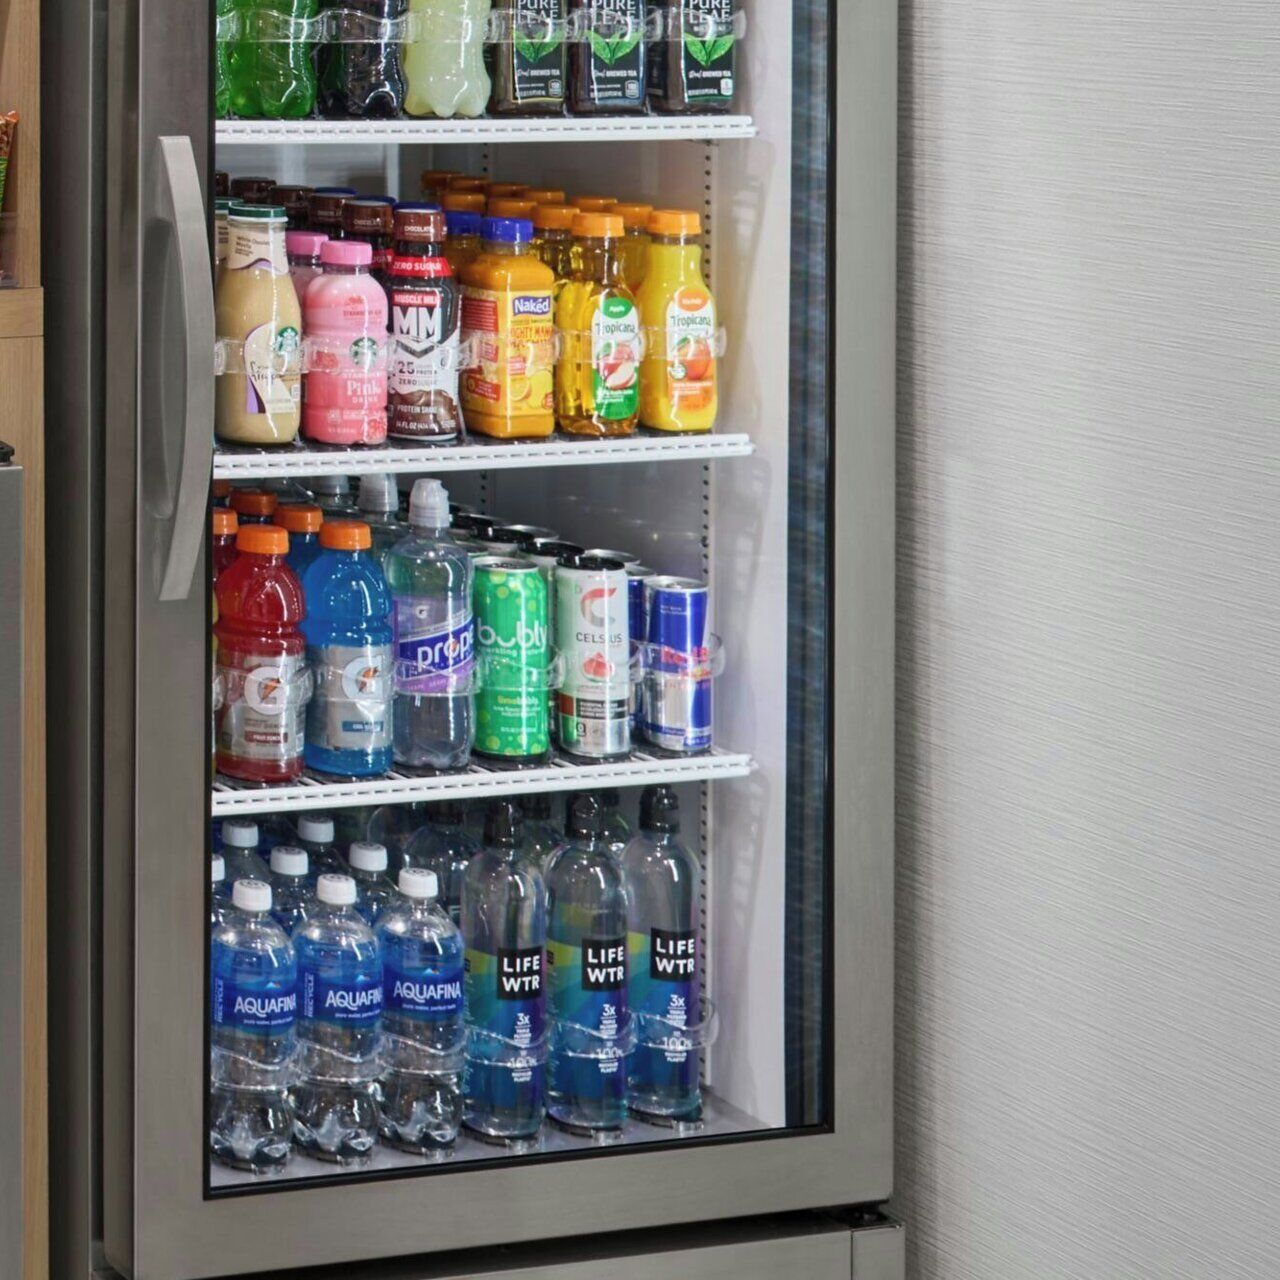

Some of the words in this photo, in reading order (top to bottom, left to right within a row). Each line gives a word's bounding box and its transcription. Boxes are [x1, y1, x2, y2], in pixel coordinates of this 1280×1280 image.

[517, 10, 558, 23] LEAF
[594, 11, 636, 25] LEAF
[690, 10, 731, 24] LEAF
[394, 262, 412, 270] ZERO
[347, 380, 380, 396] Pink
[656, 937, 695, 955] LIFE
[587, 946, 624, 964] LIFE
[503, 955, 540, 973] LIFE
[655, 956, 695, 974] WTR
[502, 975, 539, 993] WTR
[587, 967, 624, 984] WTR
[394, 981, 461, 1002] AQUAFINA
